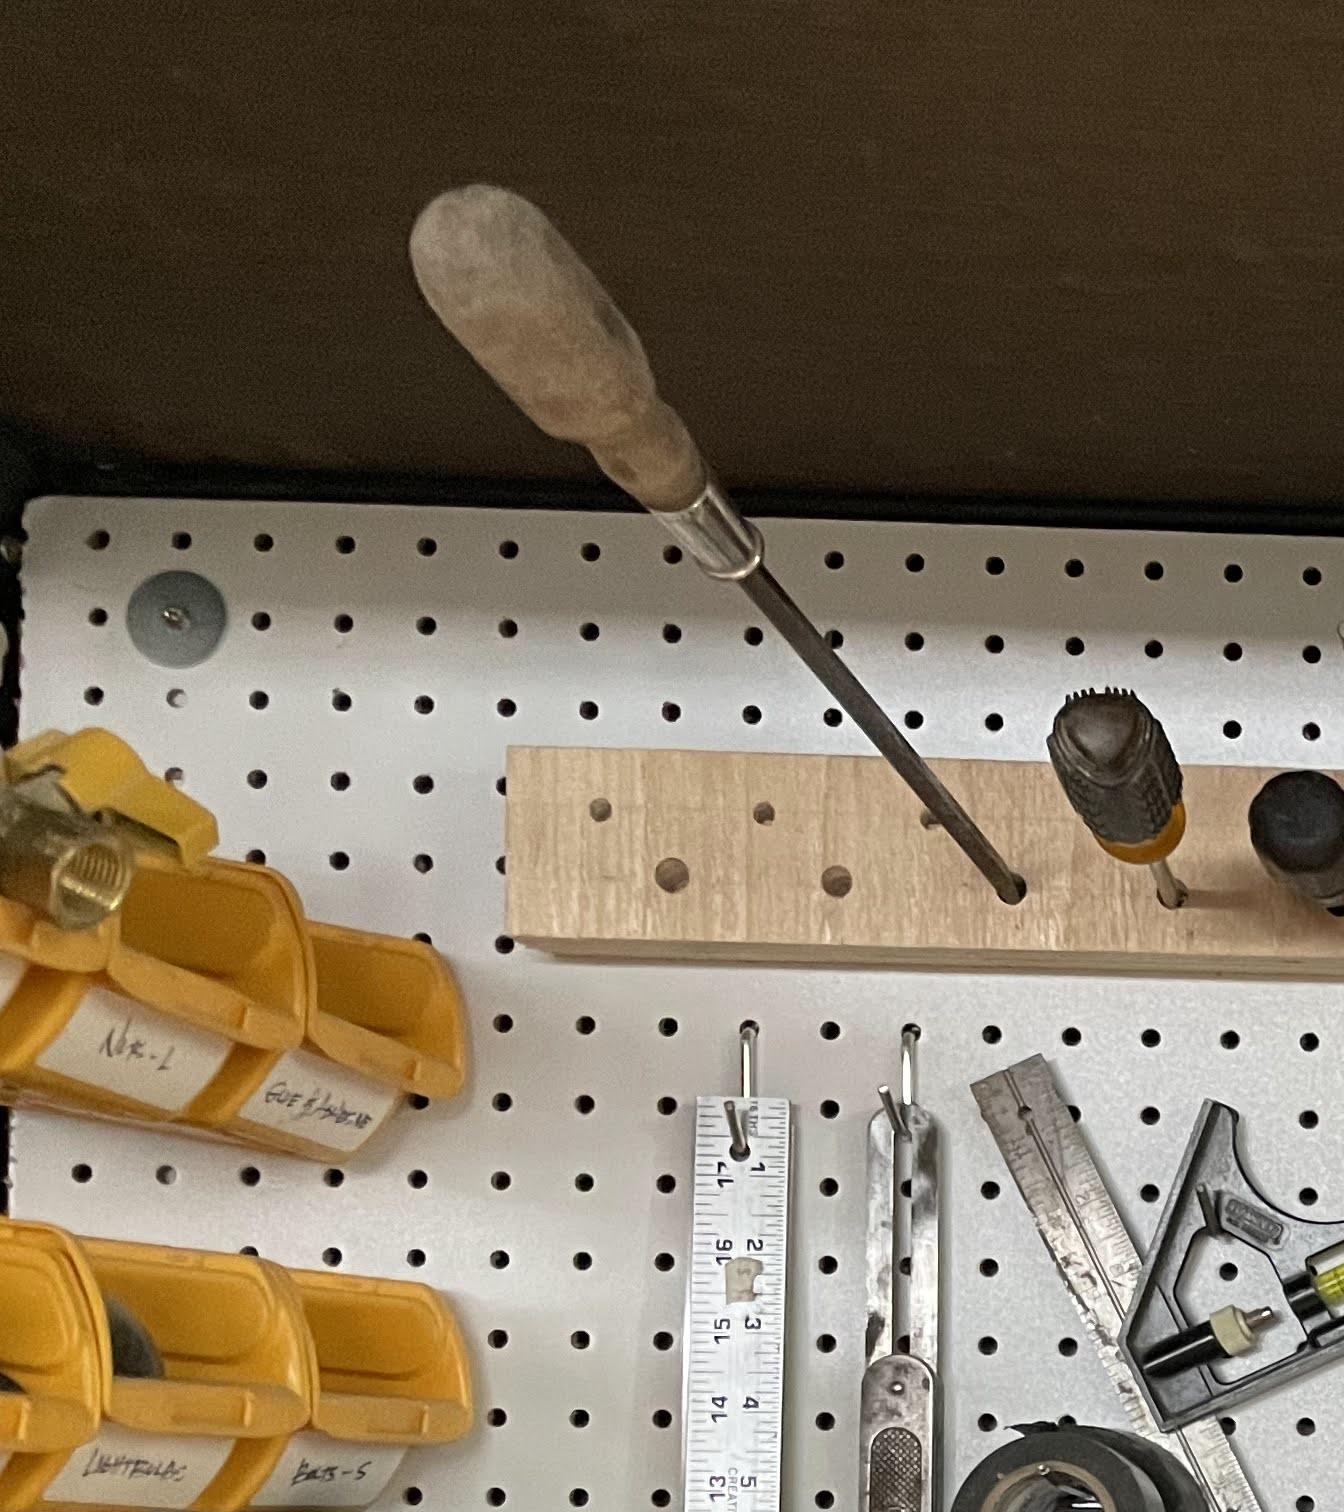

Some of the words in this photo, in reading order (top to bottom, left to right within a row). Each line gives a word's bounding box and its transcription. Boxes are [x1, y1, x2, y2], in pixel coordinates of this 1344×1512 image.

[717, 1161, 734, 1188] 17
[750, 1162, 766, 1172] 1
[715, 1238, 733, 1266] 16
[746, 1239, 763, 1251] 2
[713, 1317, 731, 1344] 15
[744, 1316, 761, 1330] 3
[711, 1396, 728, 1424] 14
[742, 1396, 759, 1409] 4
[709, 1475, 726, 1502] 13
[740, 1475, 757, 1488] 5
